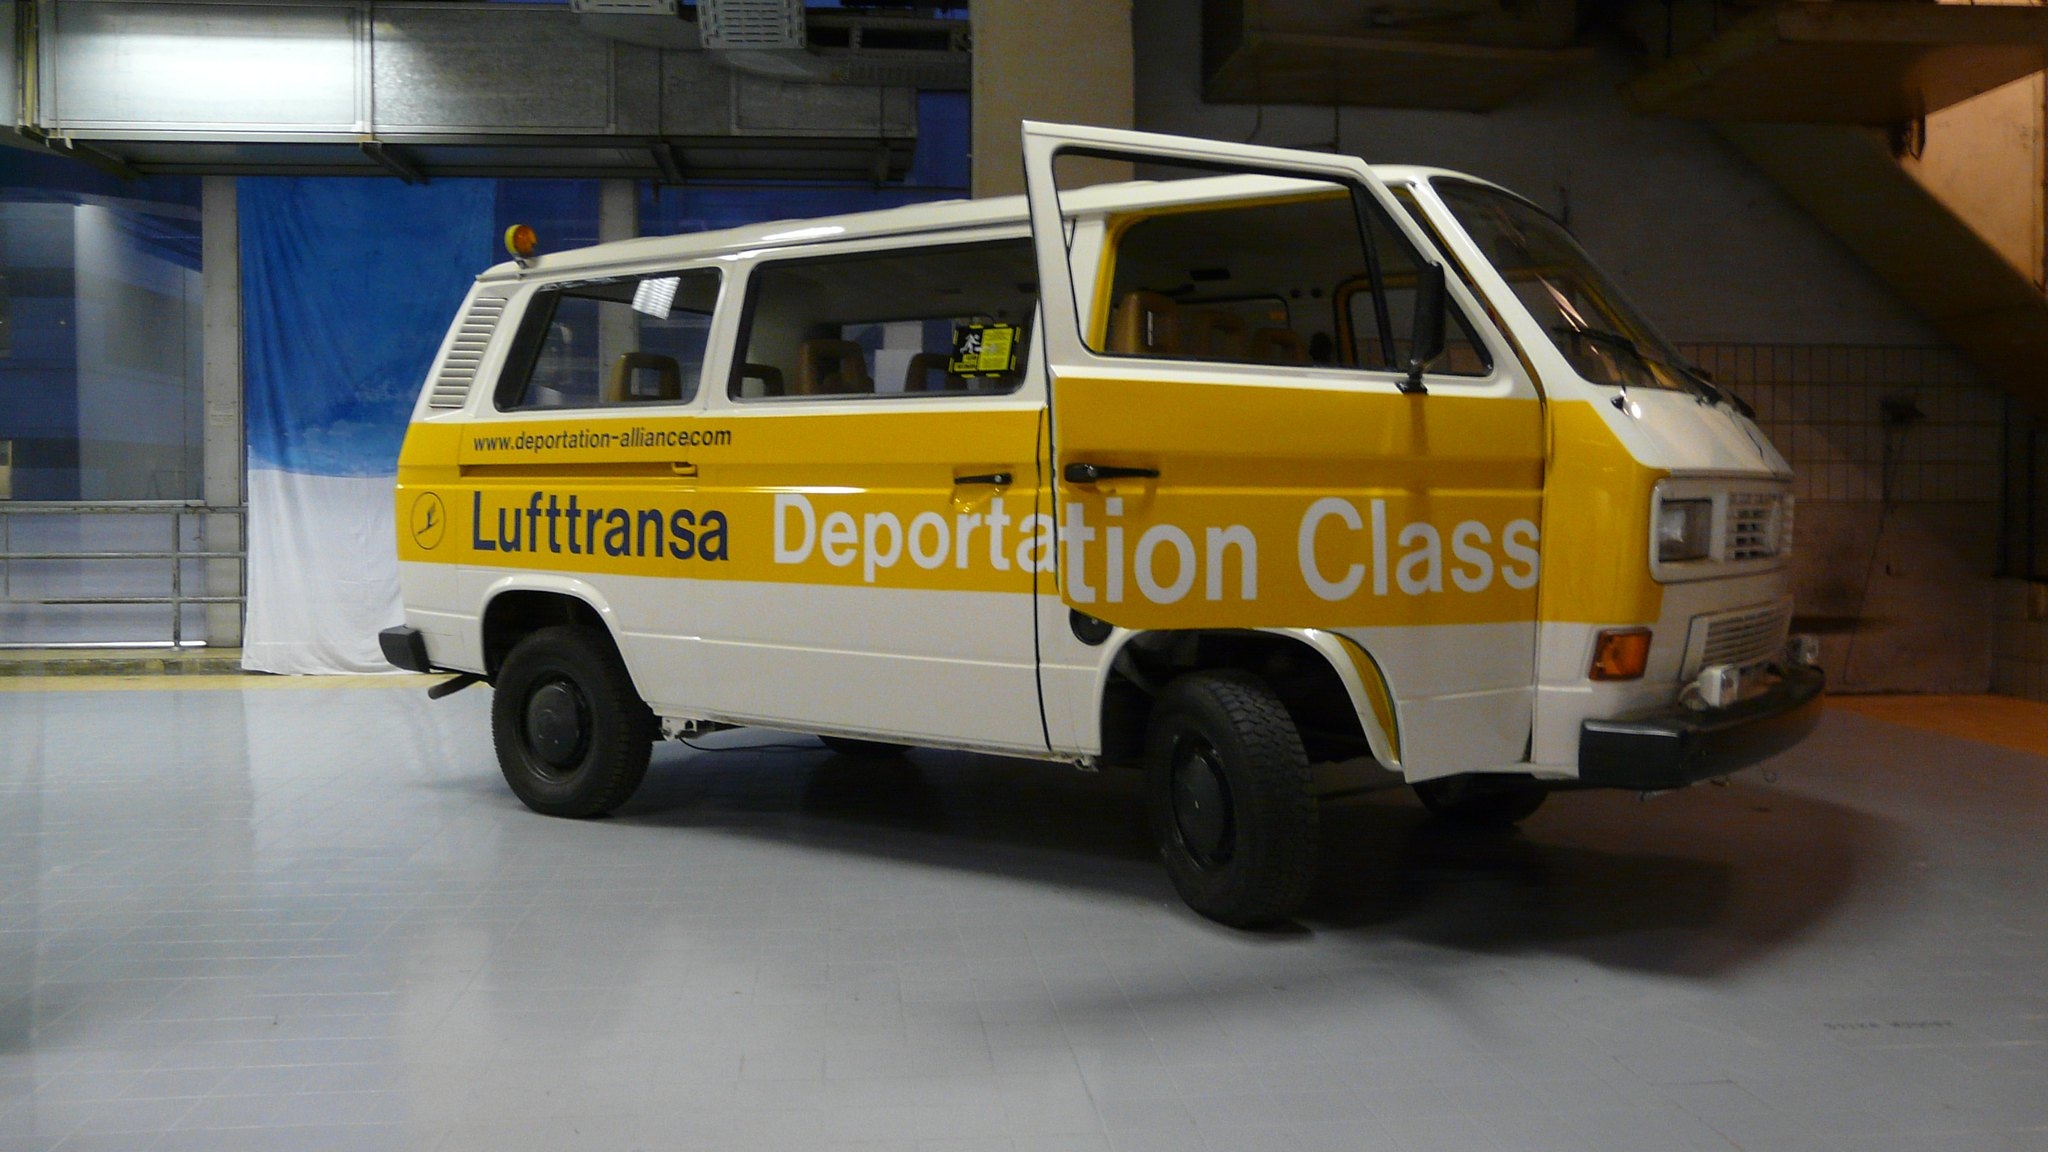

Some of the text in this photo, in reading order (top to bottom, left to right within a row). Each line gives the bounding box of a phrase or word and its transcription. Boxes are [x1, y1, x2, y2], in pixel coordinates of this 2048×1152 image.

[472, 490, 1540, 604] Lufttransa Deportation Class
